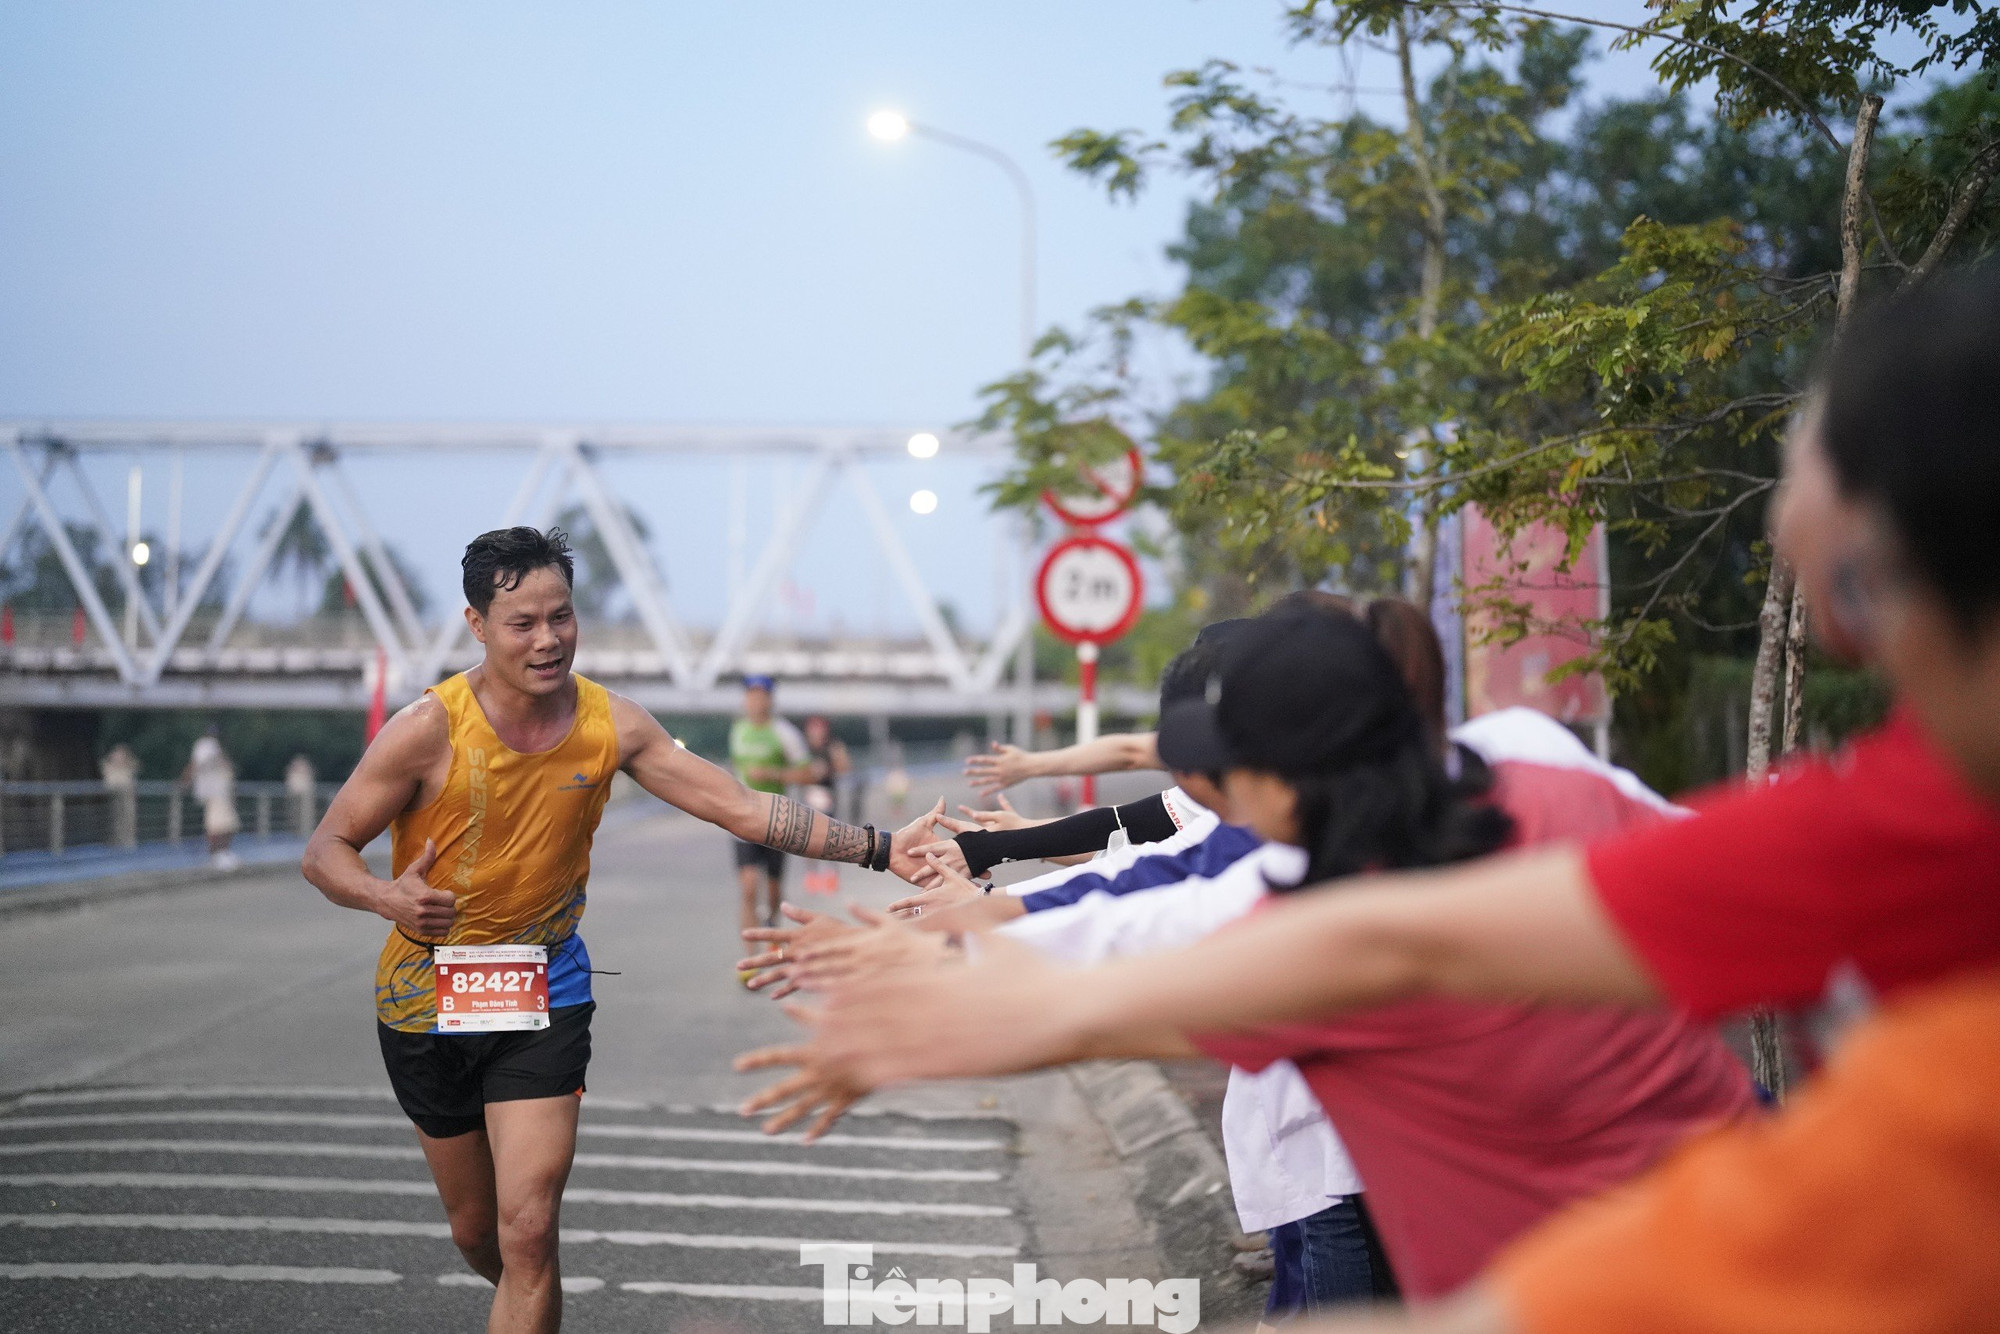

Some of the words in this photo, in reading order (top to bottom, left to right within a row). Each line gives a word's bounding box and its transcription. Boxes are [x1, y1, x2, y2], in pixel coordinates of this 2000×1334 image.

[452, 971, 535, 993] 82427
[442, 996, 455, 1011] B
[537, 995, 545, 1010] 3
